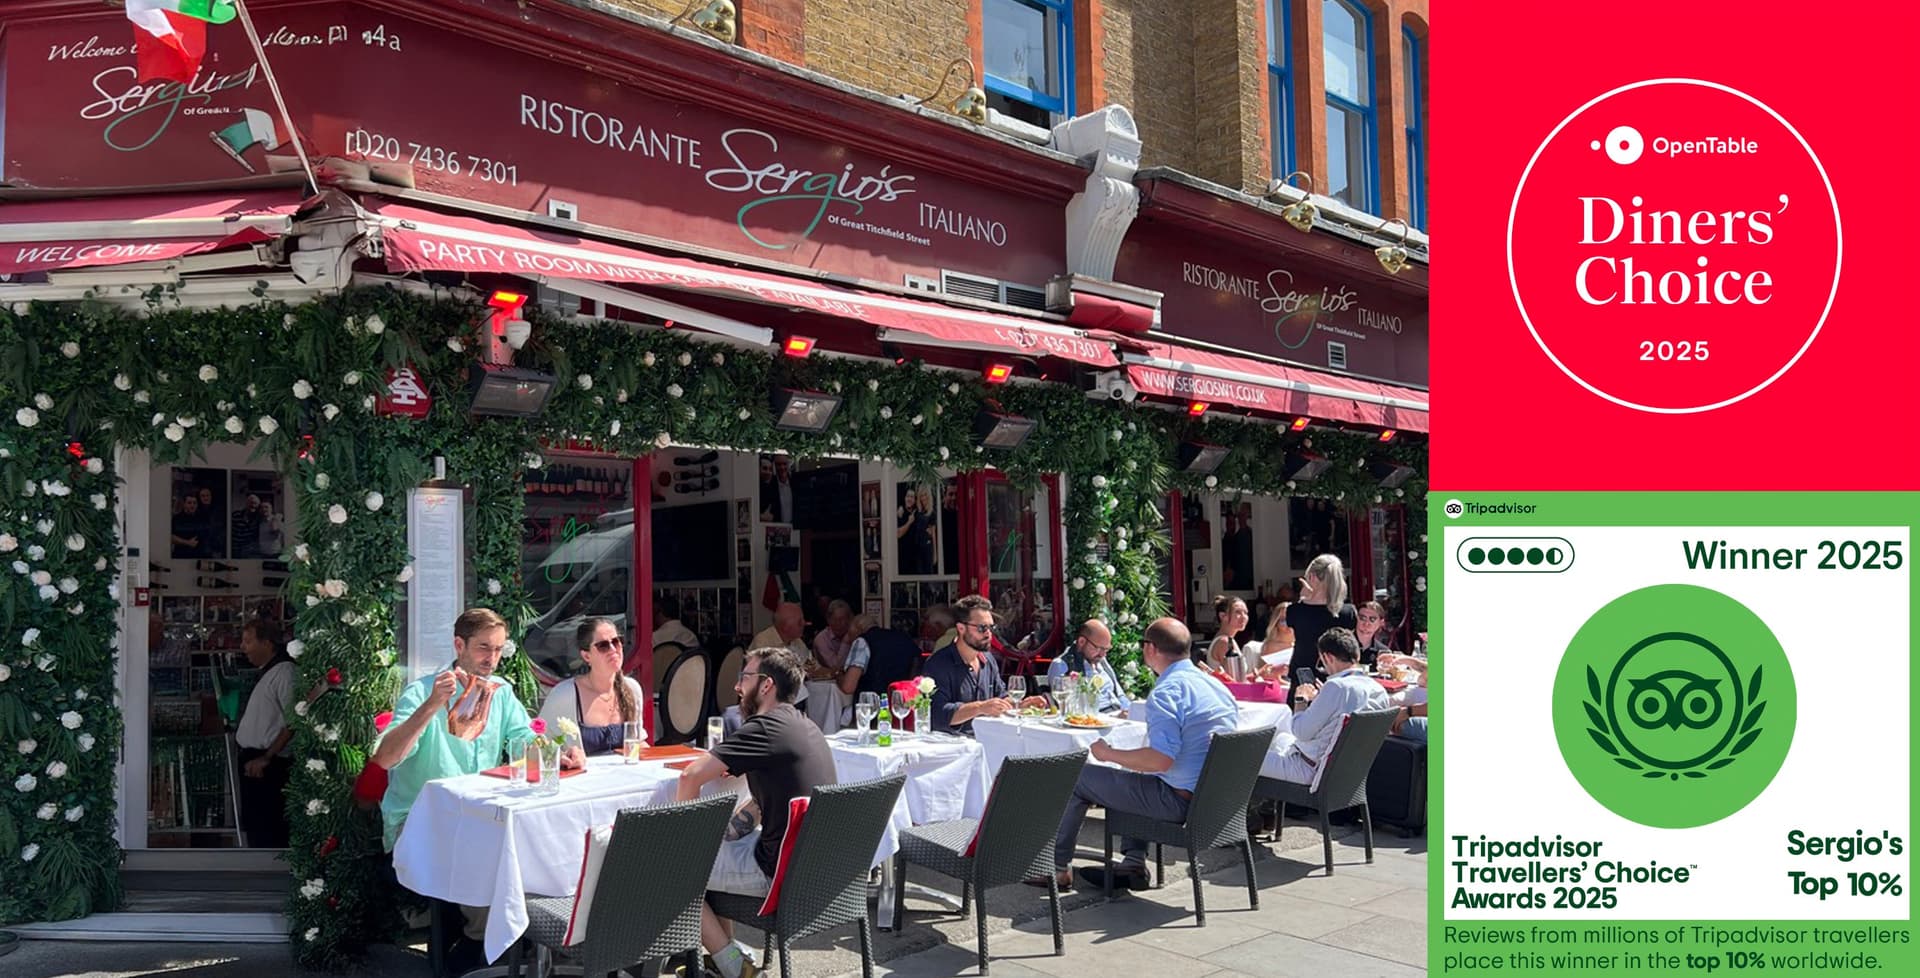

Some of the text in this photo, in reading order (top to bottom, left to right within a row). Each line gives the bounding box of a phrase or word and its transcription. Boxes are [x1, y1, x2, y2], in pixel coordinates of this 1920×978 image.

[48, 36, 126, 60] Welcome
[184, 107, 195, 116] Of
[408, 142, 461, 175] 7436
[468, 155, 517, 187] 7301
[520, 94, 1007, 249] RISTORANTE Sergio's ITALIANO
[828, 214, 931, 246] Of Great Titchfield Street
[15, 243, 167, 264] WELCOME
[419, 239, 505, 267] PARTY
[513, 251, 600, 276] ROOM
[598, 264, 665, 281] WITH
[1183, 262, 1402, 349] RISTORANTE Sergio's ITALIANO
[1142, 370, 1267, 404] WWW.SERGIOSW1.CO.UK
